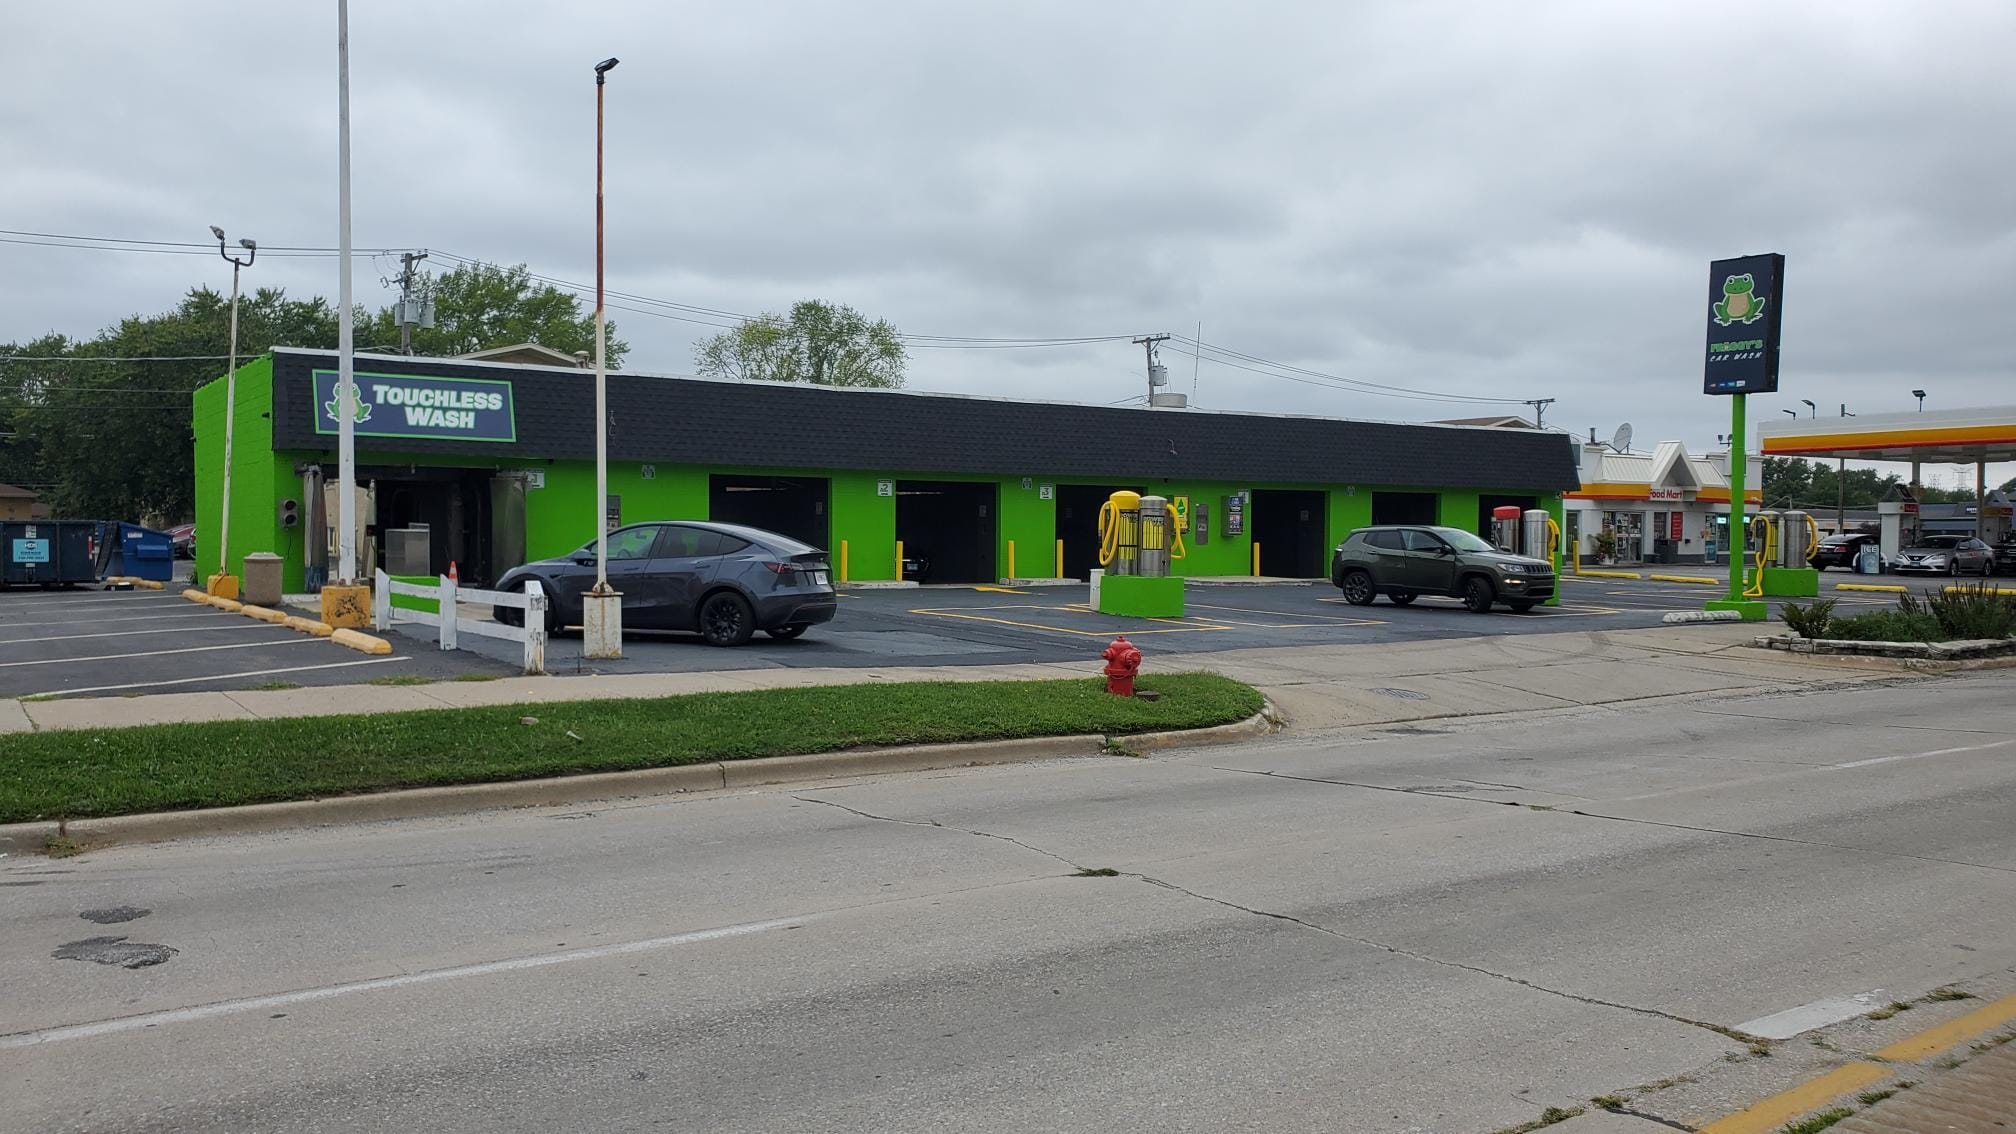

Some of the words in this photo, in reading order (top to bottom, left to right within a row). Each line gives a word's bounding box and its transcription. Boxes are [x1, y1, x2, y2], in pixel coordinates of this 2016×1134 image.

[1710, 354, 1730, 362] CAR
[1733, 351, 1763, 360] WASH
[372, 384, 503, 410] TOUCHLESS
[404, 406, 476, 429] WASH
[1666, 488, 1683, 499] Mart
[1862, 545, 1878, 553] ICE
